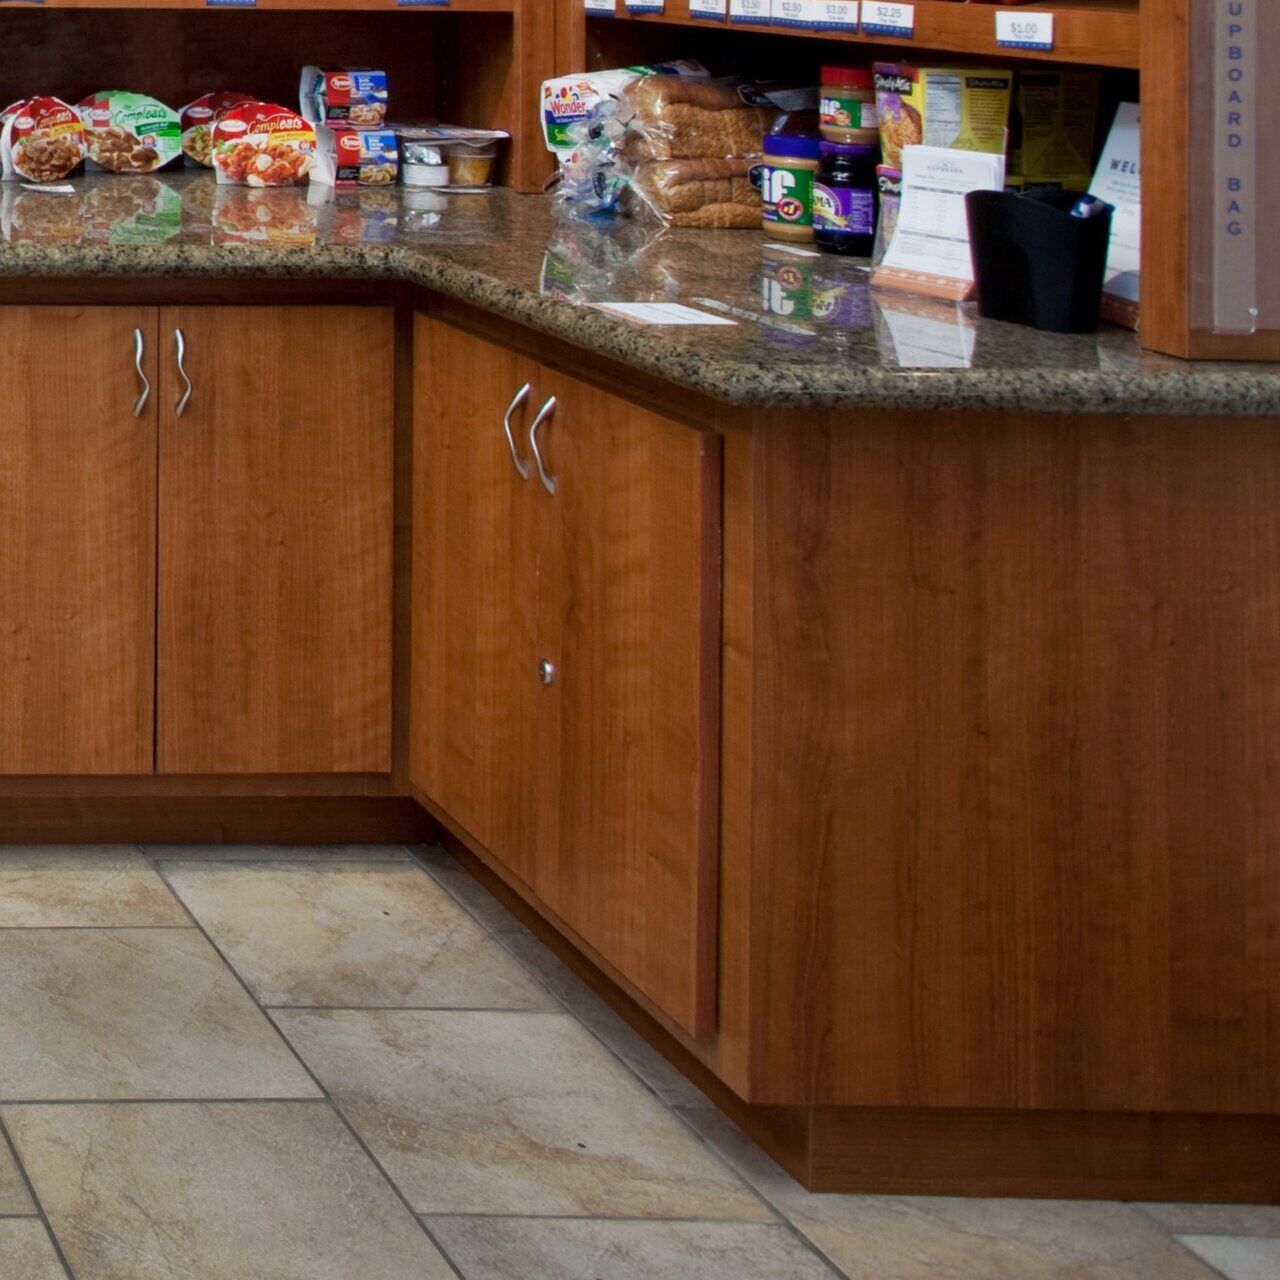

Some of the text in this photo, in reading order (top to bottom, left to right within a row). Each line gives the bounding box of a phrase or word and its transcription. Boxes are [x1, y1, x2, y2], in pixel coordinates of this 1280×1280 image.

[877, 6, 902, 20] $2.25
[1011, 22, 1038, 35] $1.00
[113, 108, 168, 127] Compleats
[551, 101, 587, 118] Wonder
[246, 117, 303, 137] Compleats
[1227, 178, 1242, 236] BAG
